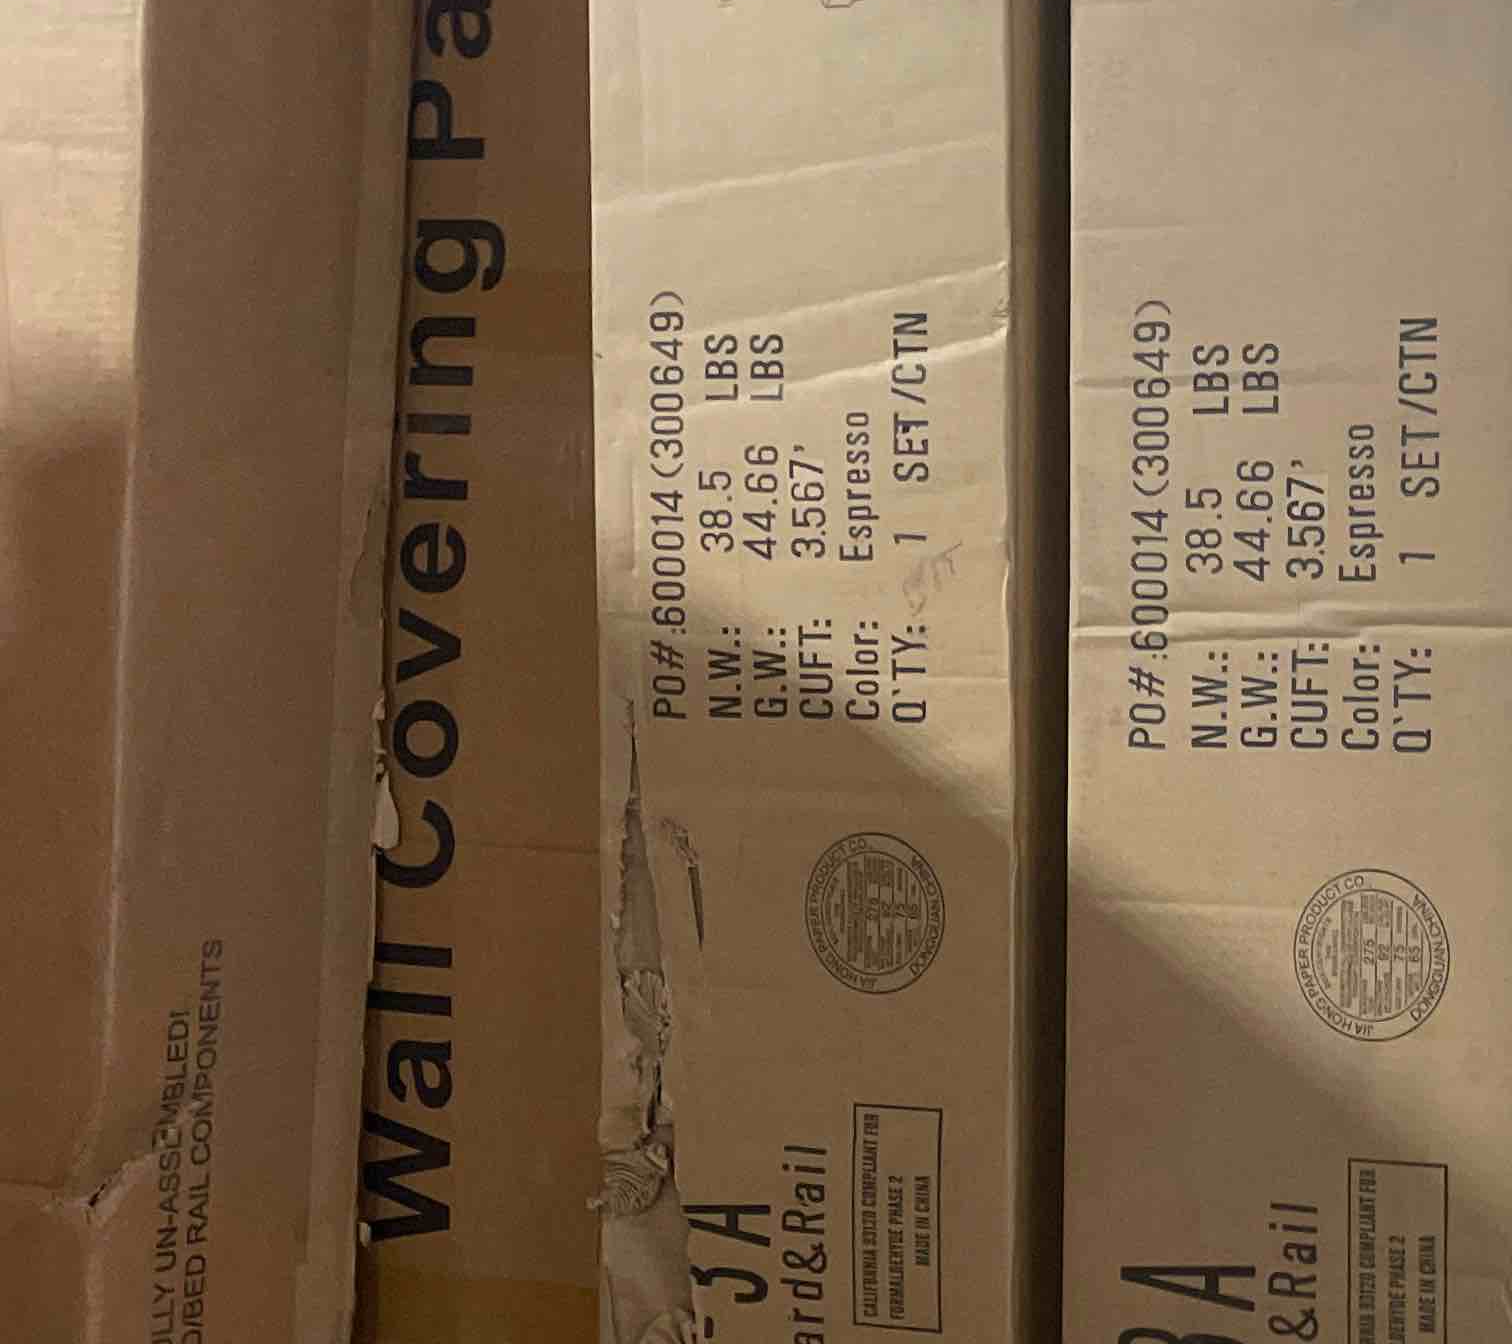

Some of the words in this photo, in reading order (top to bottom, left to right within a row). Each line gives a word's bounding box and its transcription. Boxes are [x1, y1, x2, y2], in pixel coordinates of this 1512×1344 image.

[703, 334, 738, 401] LBS
[750, 334, 784, 401] LBS
[1192, 344, 1229, 415] LBS
[1242, 343, 1279, 415] LBS
[699, 470, 733, 552] 38.5
[743, 445, 779, 560] 44.66
[840, 411, 879, 561] Espresso
[1233, 459, 1275, 582] 44.66
[1338, 424, 1383, 582] Espresso
[374, 214, 508, 892] Covering
[893, 533, 925, 543] 1
[1184, 488, 1223, 575] 38.5
[1398, 552, 1436, 564] 1
[708, 627, 740, 719] N.W.:
[753, 628, 787, 718] G.W.:
[798, 619, 833, 720] CUFT:
[844, 621, 879, 720] Color:
[1191, 651, 1228, 749] N.W.:
[1240, 653, 1278, 748] G.W.:
[1290, 643, 1329, 749] CUFT:
[1341, 644, 1380, 750] Color:
[1298, 883, 1340, 945] PRODUCT
[1298, 947, 1320, 997] PAPER
[188, 938, 224, 1167] COMPONENTS
[362, 944, 456, 1248] Wall
[182, 1174, 211, 1247] RAIL
[915, 1176, 930, 1213] CHINA
[915, 1216, 929, 1229] IN
[915, 1233, 930, 1266] MADE
[1389, 1235, 1405, 1245] 2
[1418, 1235, 1436, 1275] CHINA
[1419, 1279, 1436, 1293] IN
